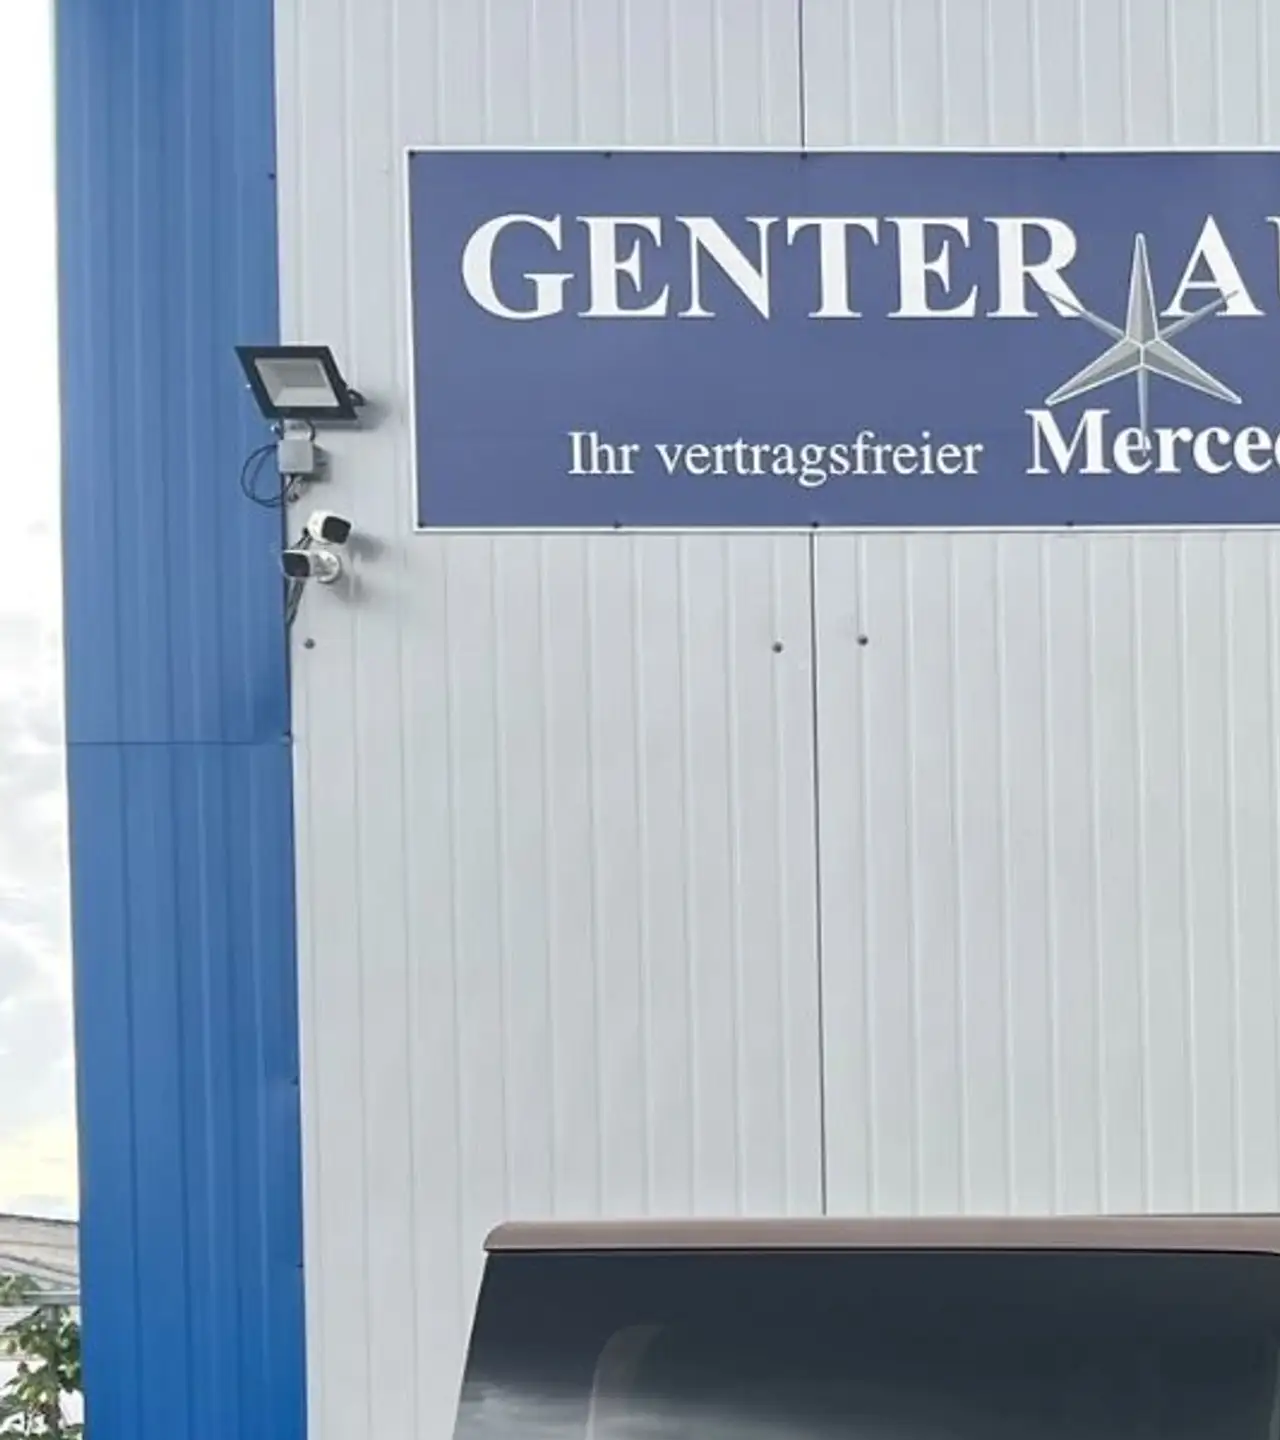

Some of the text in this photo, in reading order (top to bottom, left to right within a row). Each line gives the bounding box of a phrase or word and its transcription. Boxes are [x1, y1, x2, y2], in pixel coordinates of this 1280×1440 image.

[461, 212, 1086, 321] GENTER
[567, 430, 641, 476] Ihr
[654, 429, 986, 488] vertragsfreier
